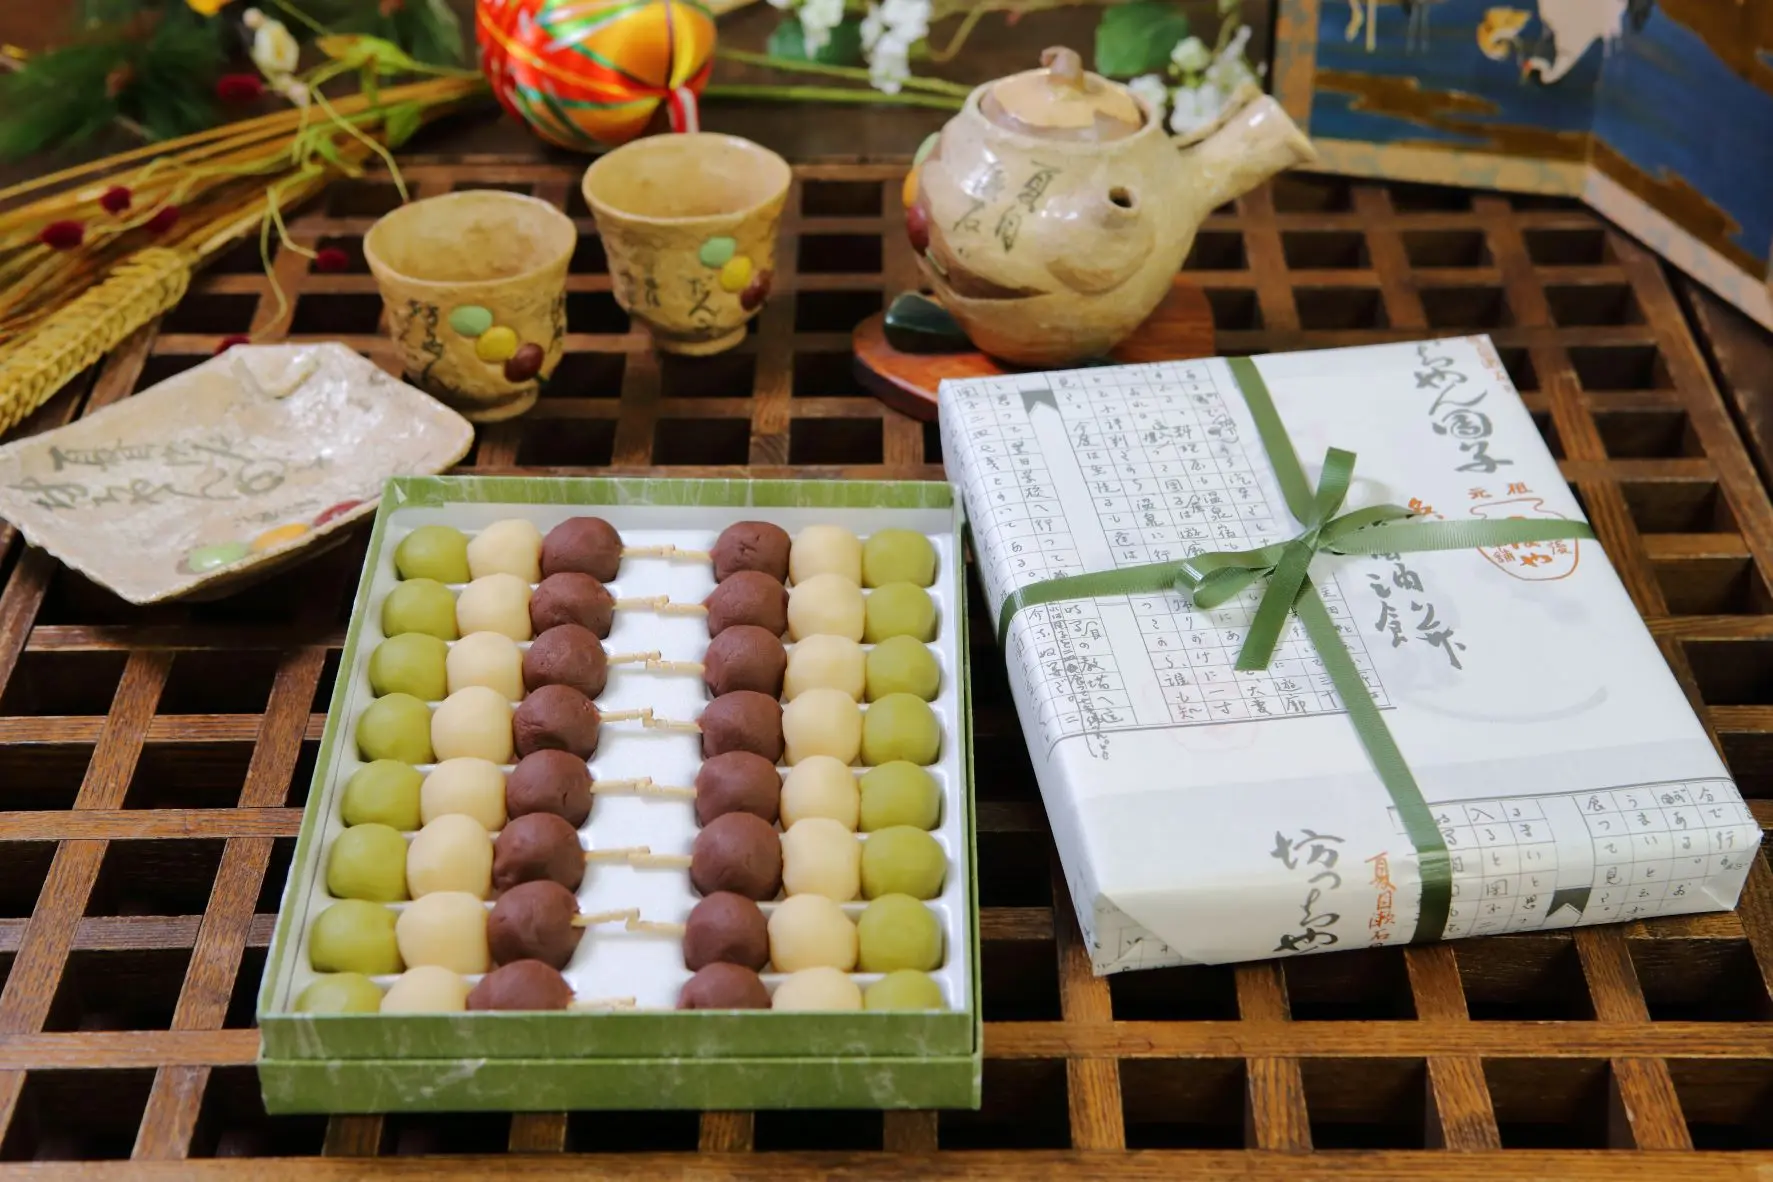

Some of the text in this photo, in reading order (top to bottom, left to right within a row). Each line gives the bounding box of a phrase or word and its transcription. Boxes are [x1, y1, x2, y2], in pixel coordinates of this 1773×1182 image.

[1467, 482, 1534, 500] 元祖
[1364, 552, 1467, 670] 油餅
[1363, 851, 1397, 948] 夏目漱石
